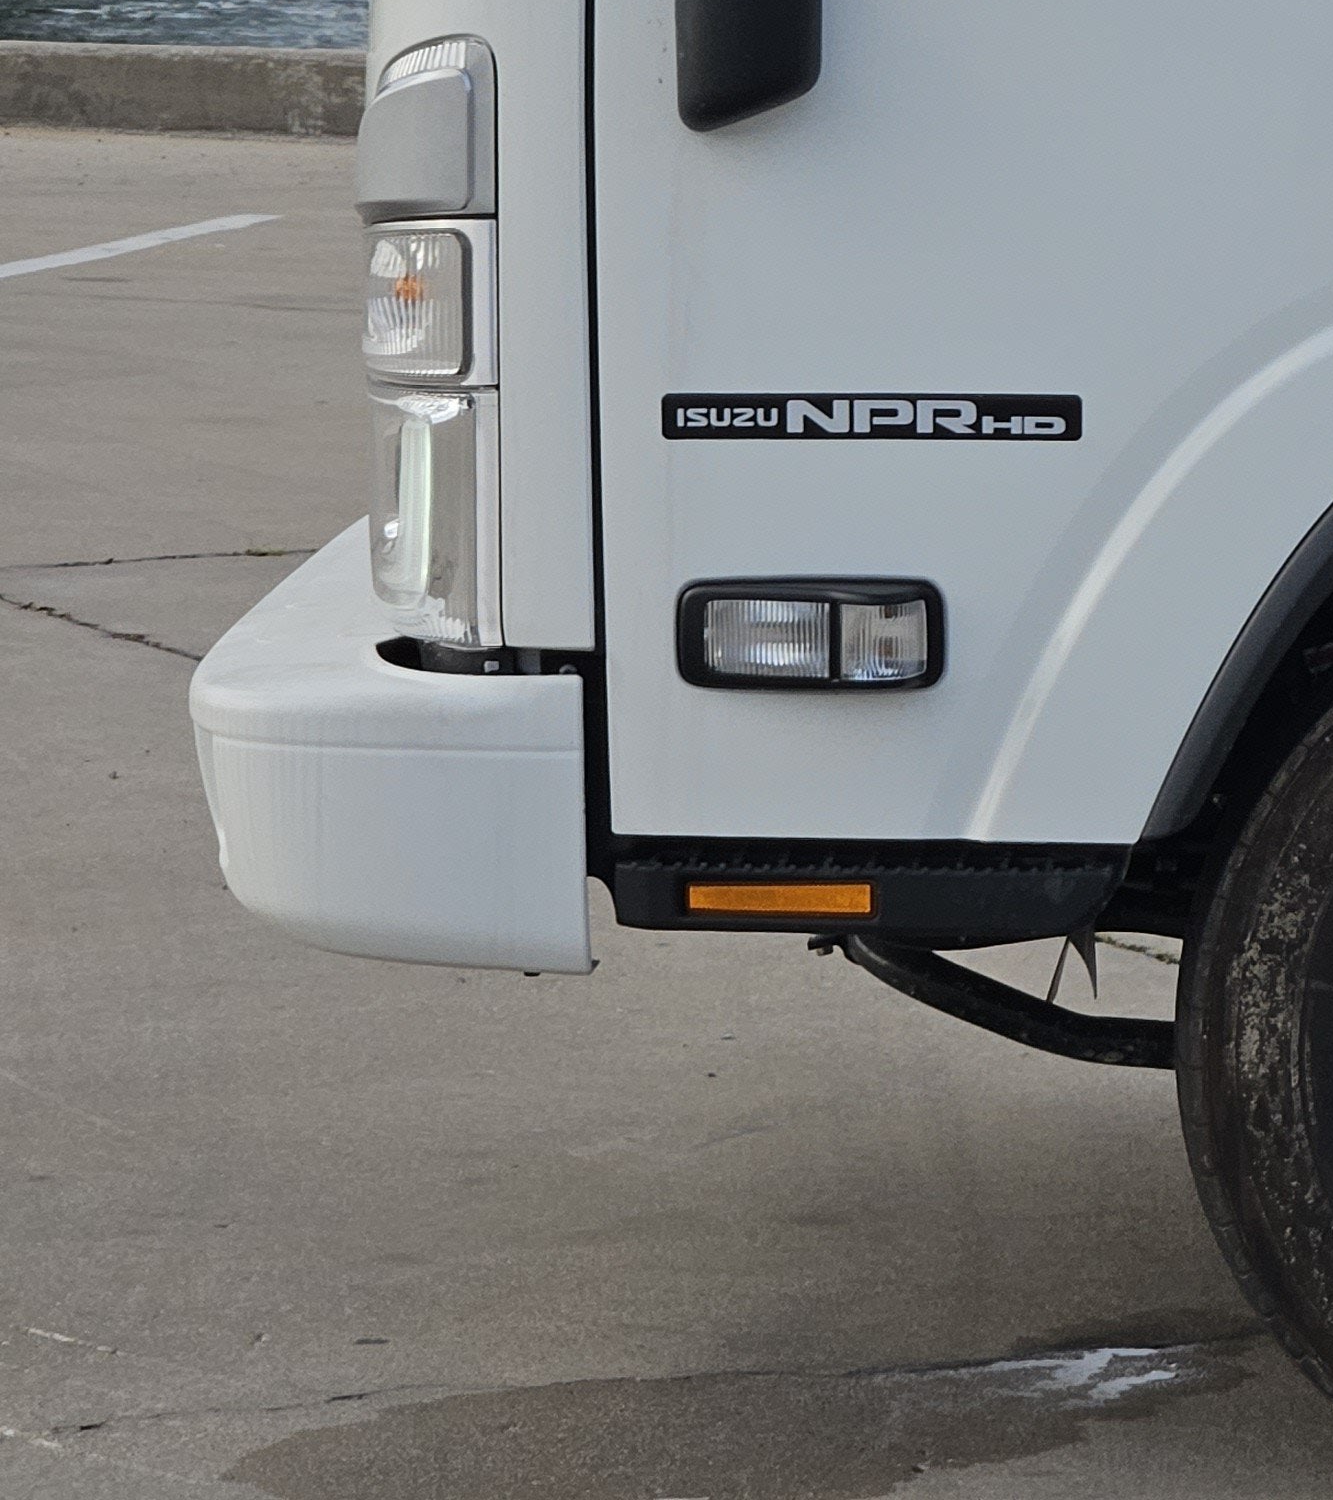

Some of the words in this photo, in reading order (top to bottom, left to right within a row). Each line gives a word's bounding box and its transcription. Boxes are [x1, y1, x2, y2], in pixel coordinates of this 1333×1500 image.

[676, 407, 779, 428] ISUZU
[786, 399, 977, 434] NPR
[981, 415, 1067, 435] HD
